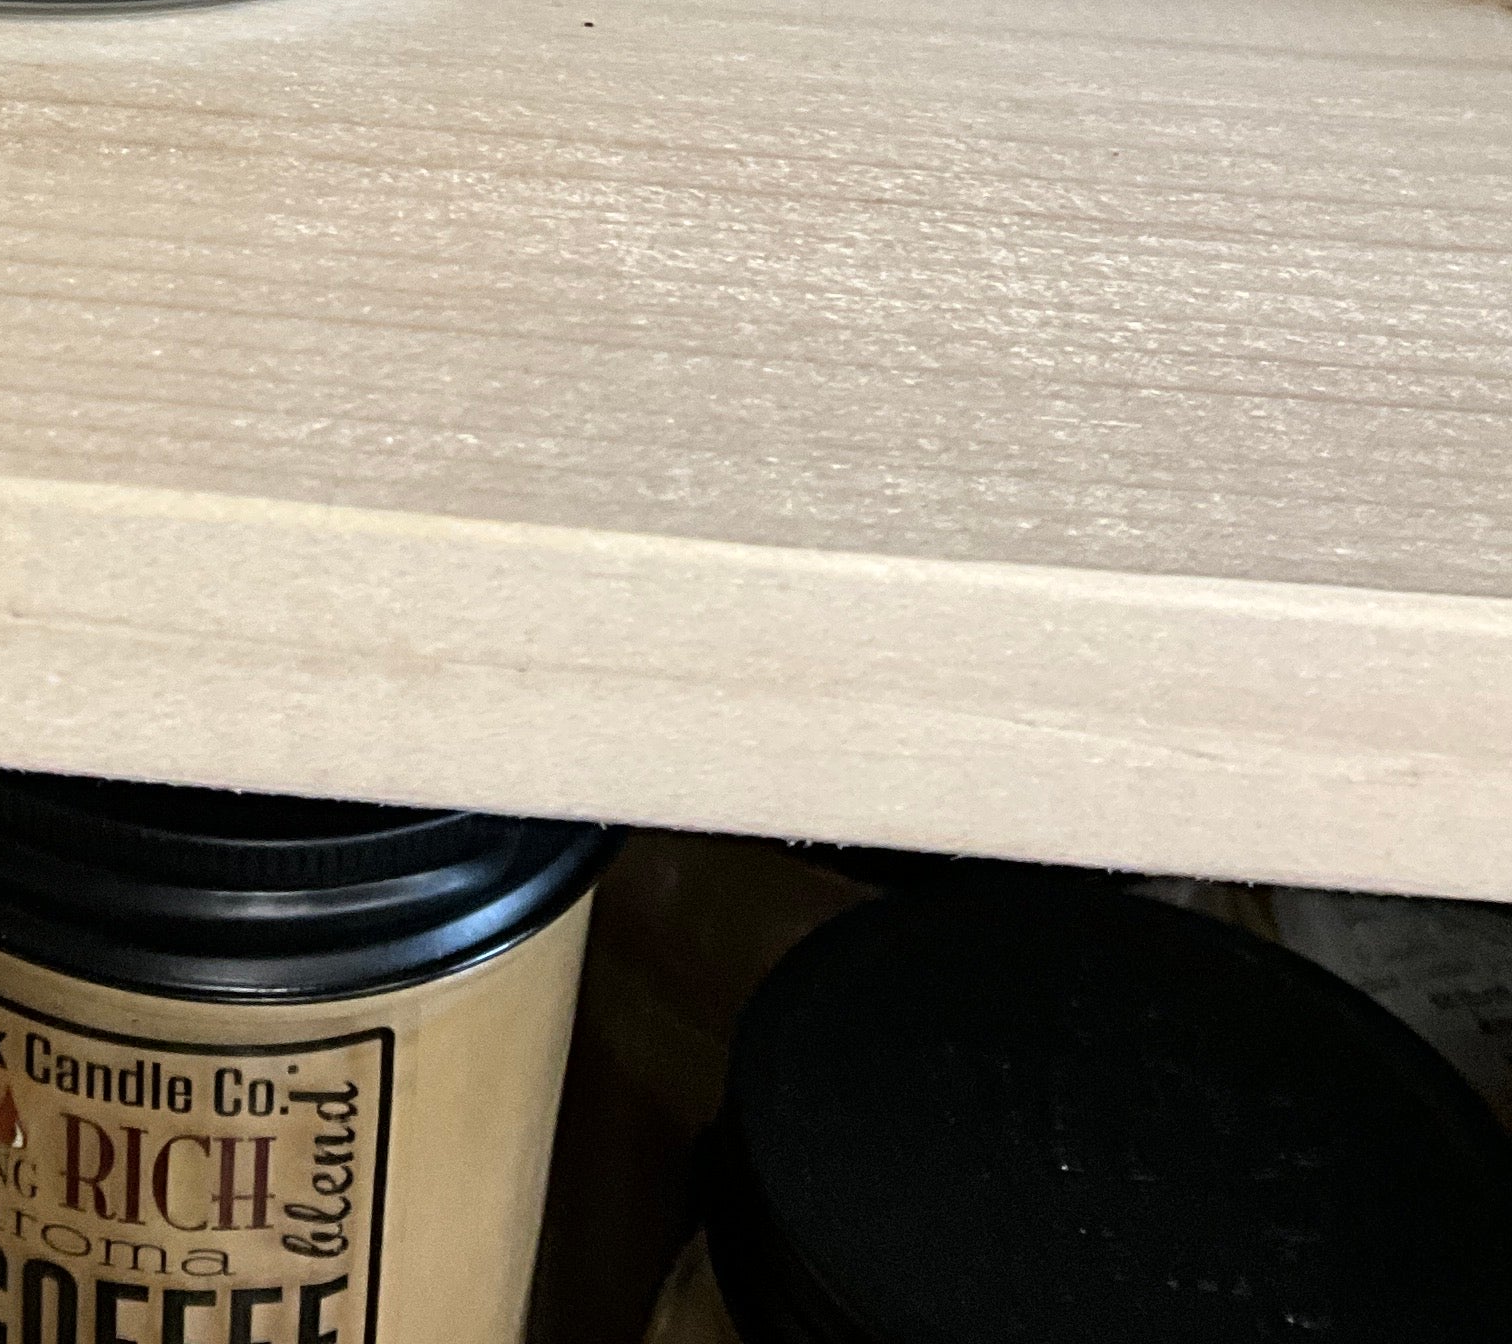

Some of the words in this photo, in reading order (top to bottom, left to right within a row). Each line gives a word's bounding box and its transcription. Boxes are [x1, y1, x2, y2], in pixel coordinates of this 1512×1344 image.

[24, 1030, 194, 1115] Candle
[213, 1067, 289, 1116] Co.
[59, 1112, 277, 1232] RICH
[281, 1080, 360, 1258] blend
